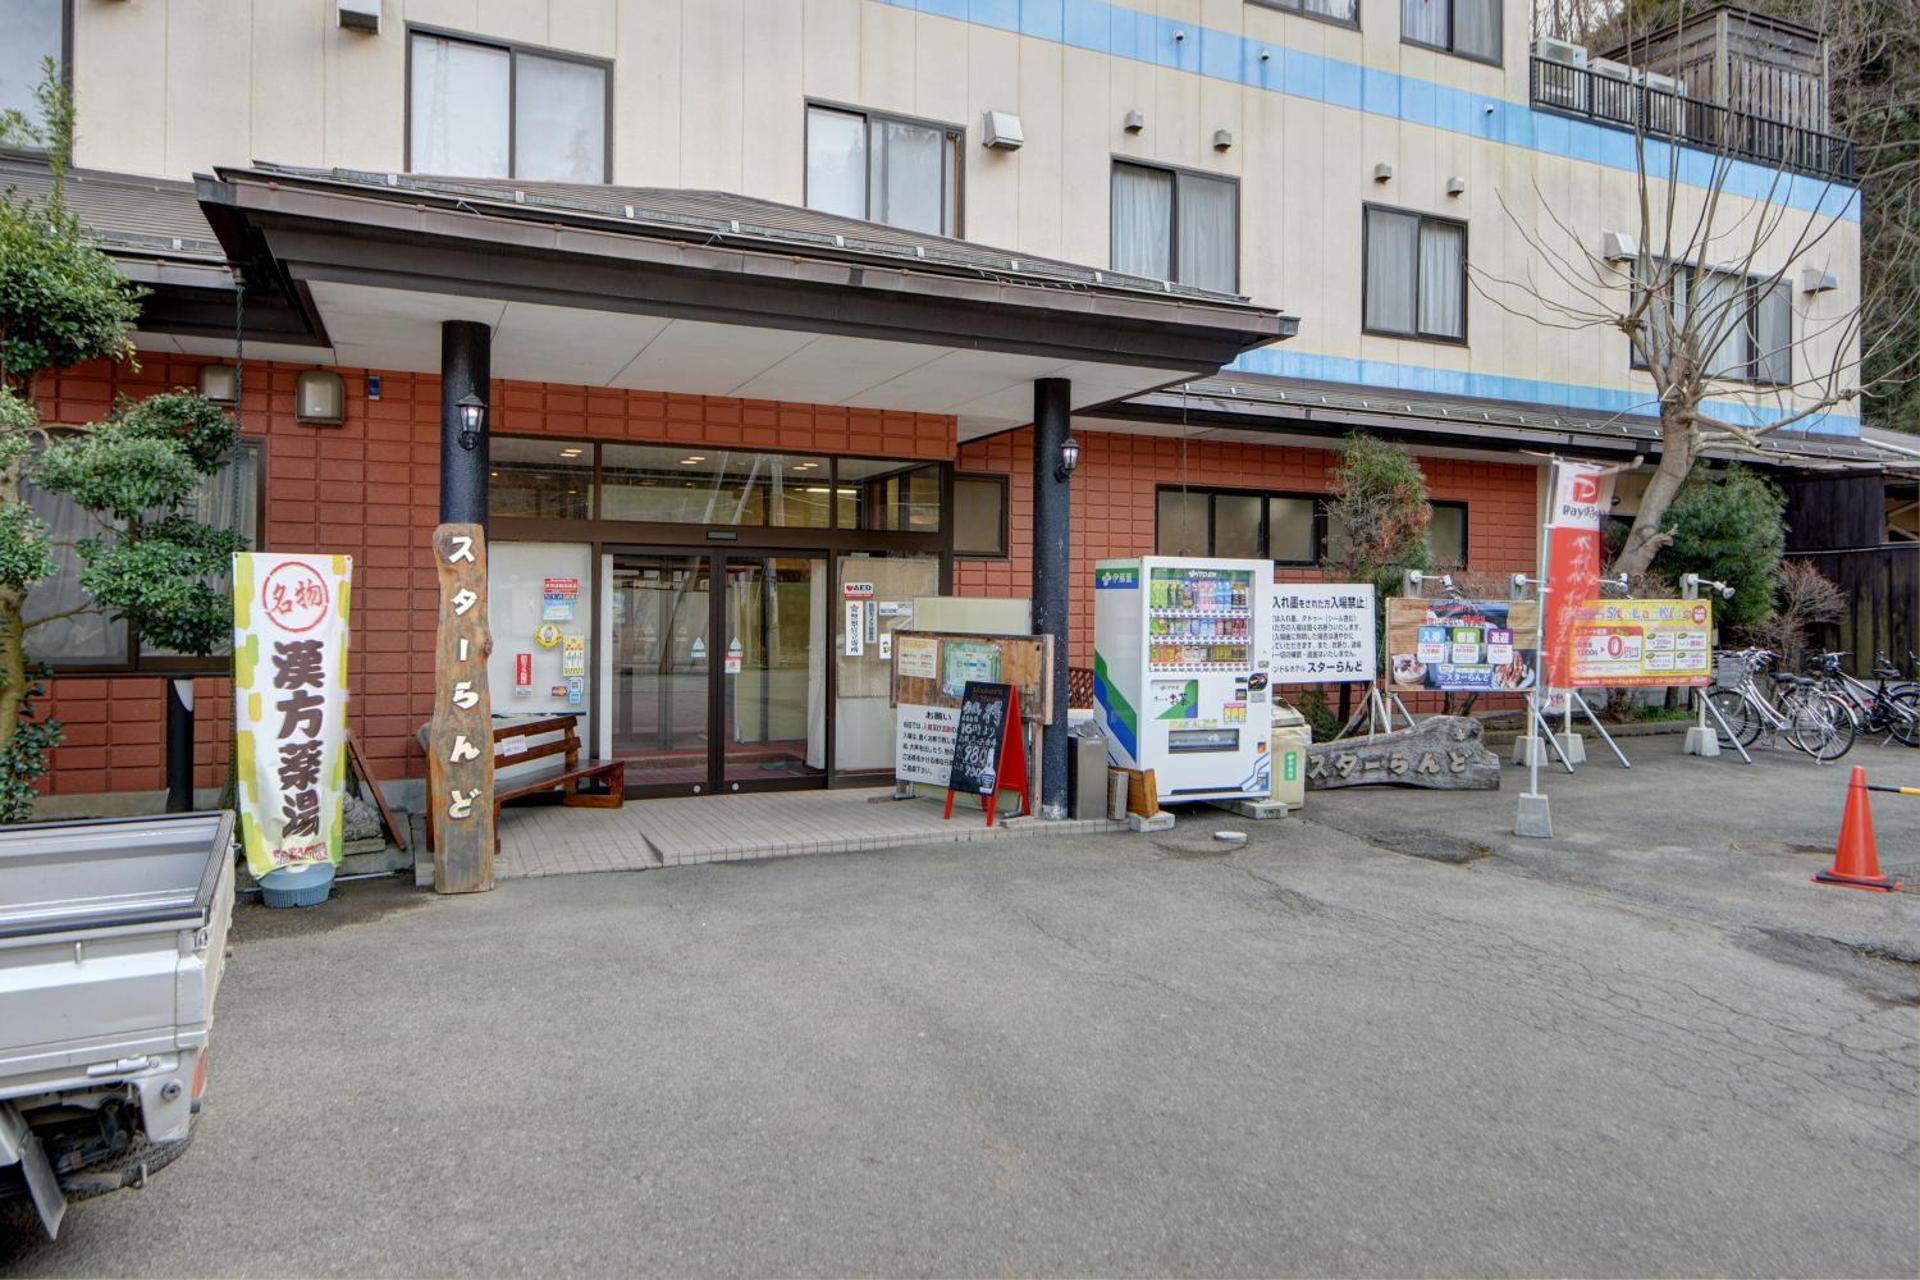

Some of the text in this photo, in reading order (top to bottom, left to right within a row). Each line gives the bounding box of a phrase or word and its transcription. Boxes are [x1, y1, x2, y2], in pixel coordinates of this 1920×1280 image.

[271, 578, 323, 616] 名物
[1272, 595, 1365, 609] 入れ墨をされた方入場禁止
[447, 535, 483, 820] スターらんど
[1307, 660, 1363, 673] スターらんど
[925, 711, 952, 721] お願い
[271, 639, 326, 839] 漢方薬湯
[1308, 750, 1473, 780] スターらんど
